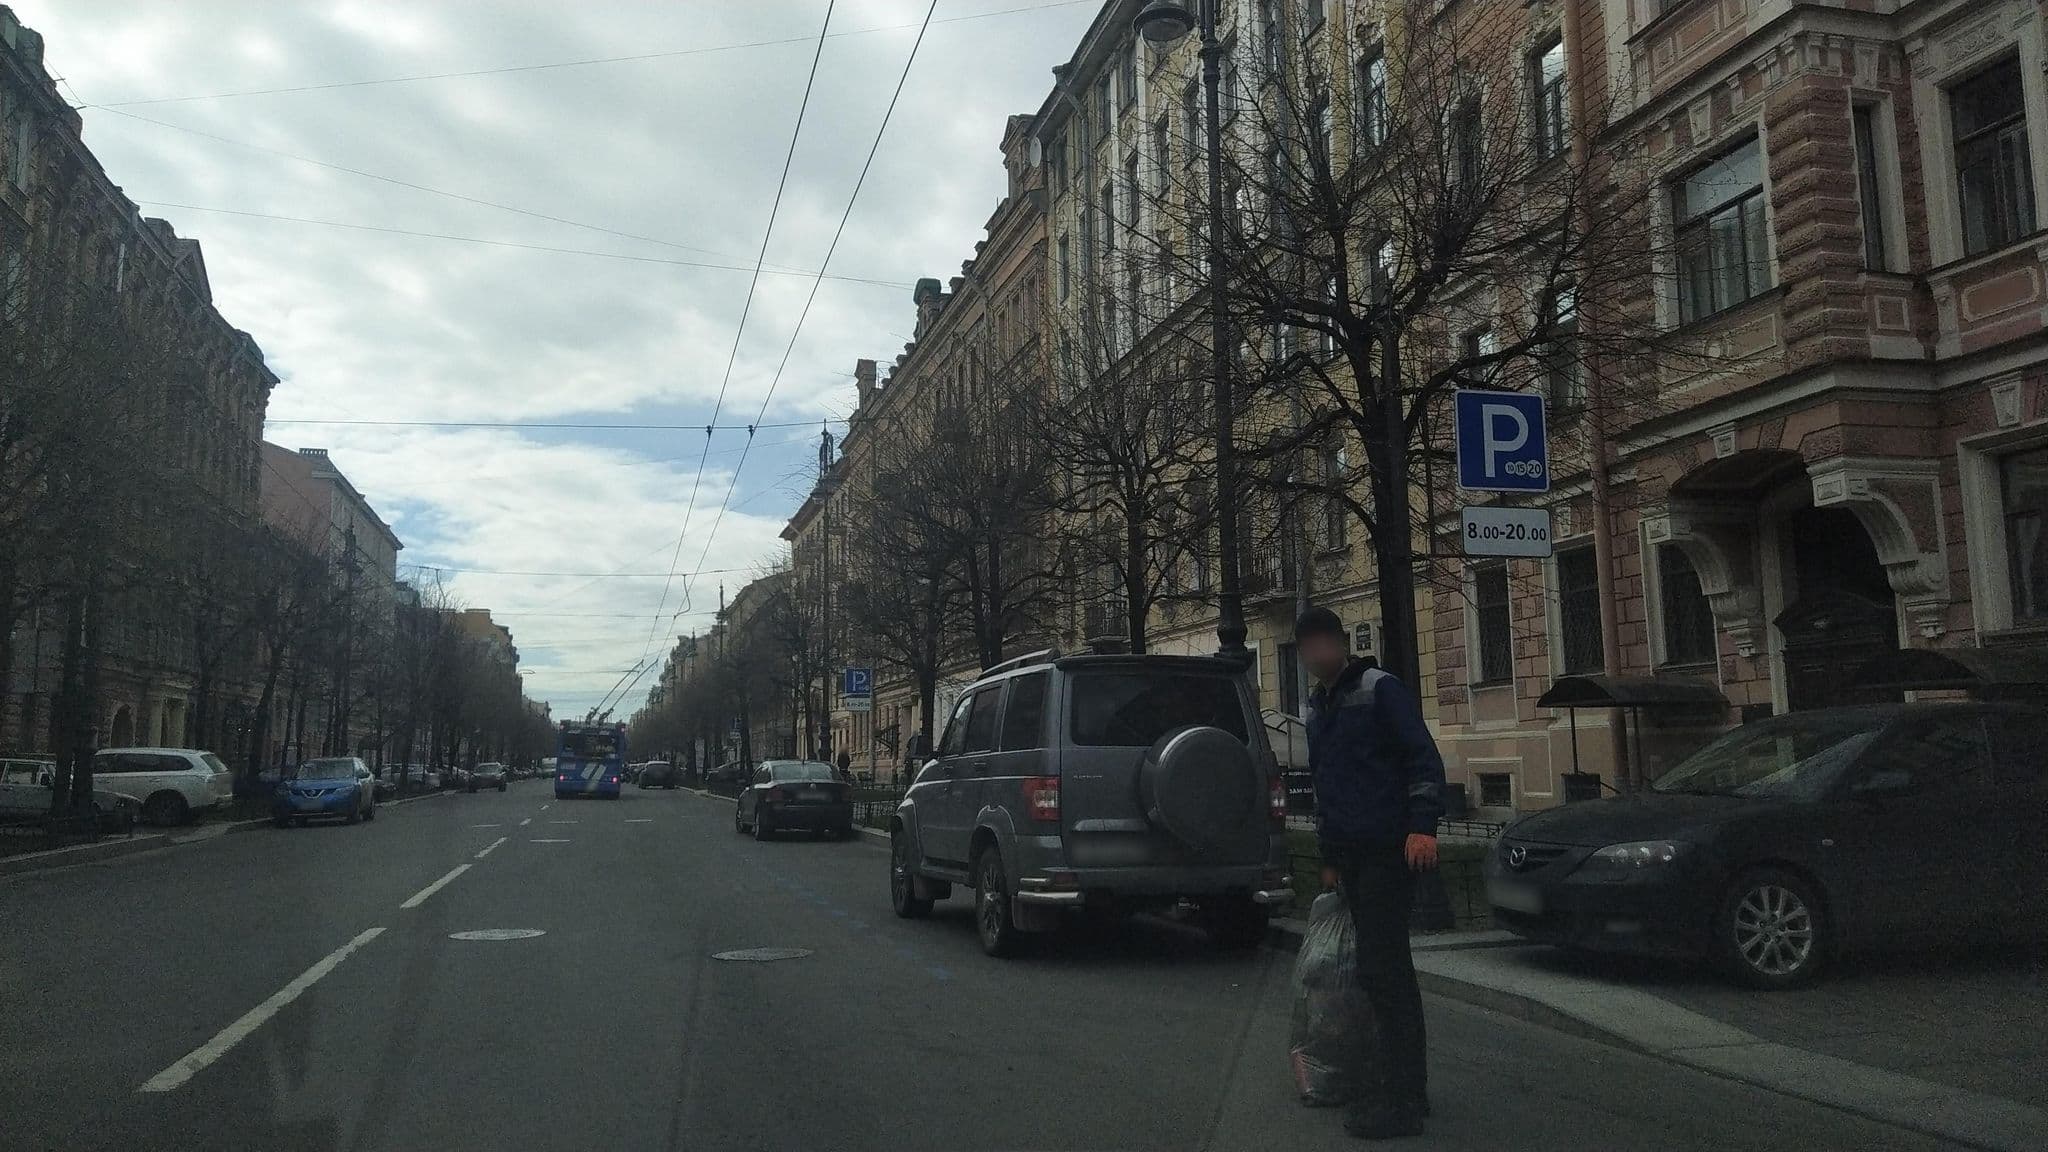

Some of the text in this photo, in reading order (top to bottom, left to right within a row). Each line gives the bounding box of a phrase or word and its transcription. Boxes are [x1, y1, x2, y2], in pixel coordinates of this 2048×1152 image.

[1482, 404, 1529, 478] P
[1528, 463, 1541, 475] 20
[1467, 522, 1547, 541] 8.00-20.00
[853, 670, 866, 692] P
